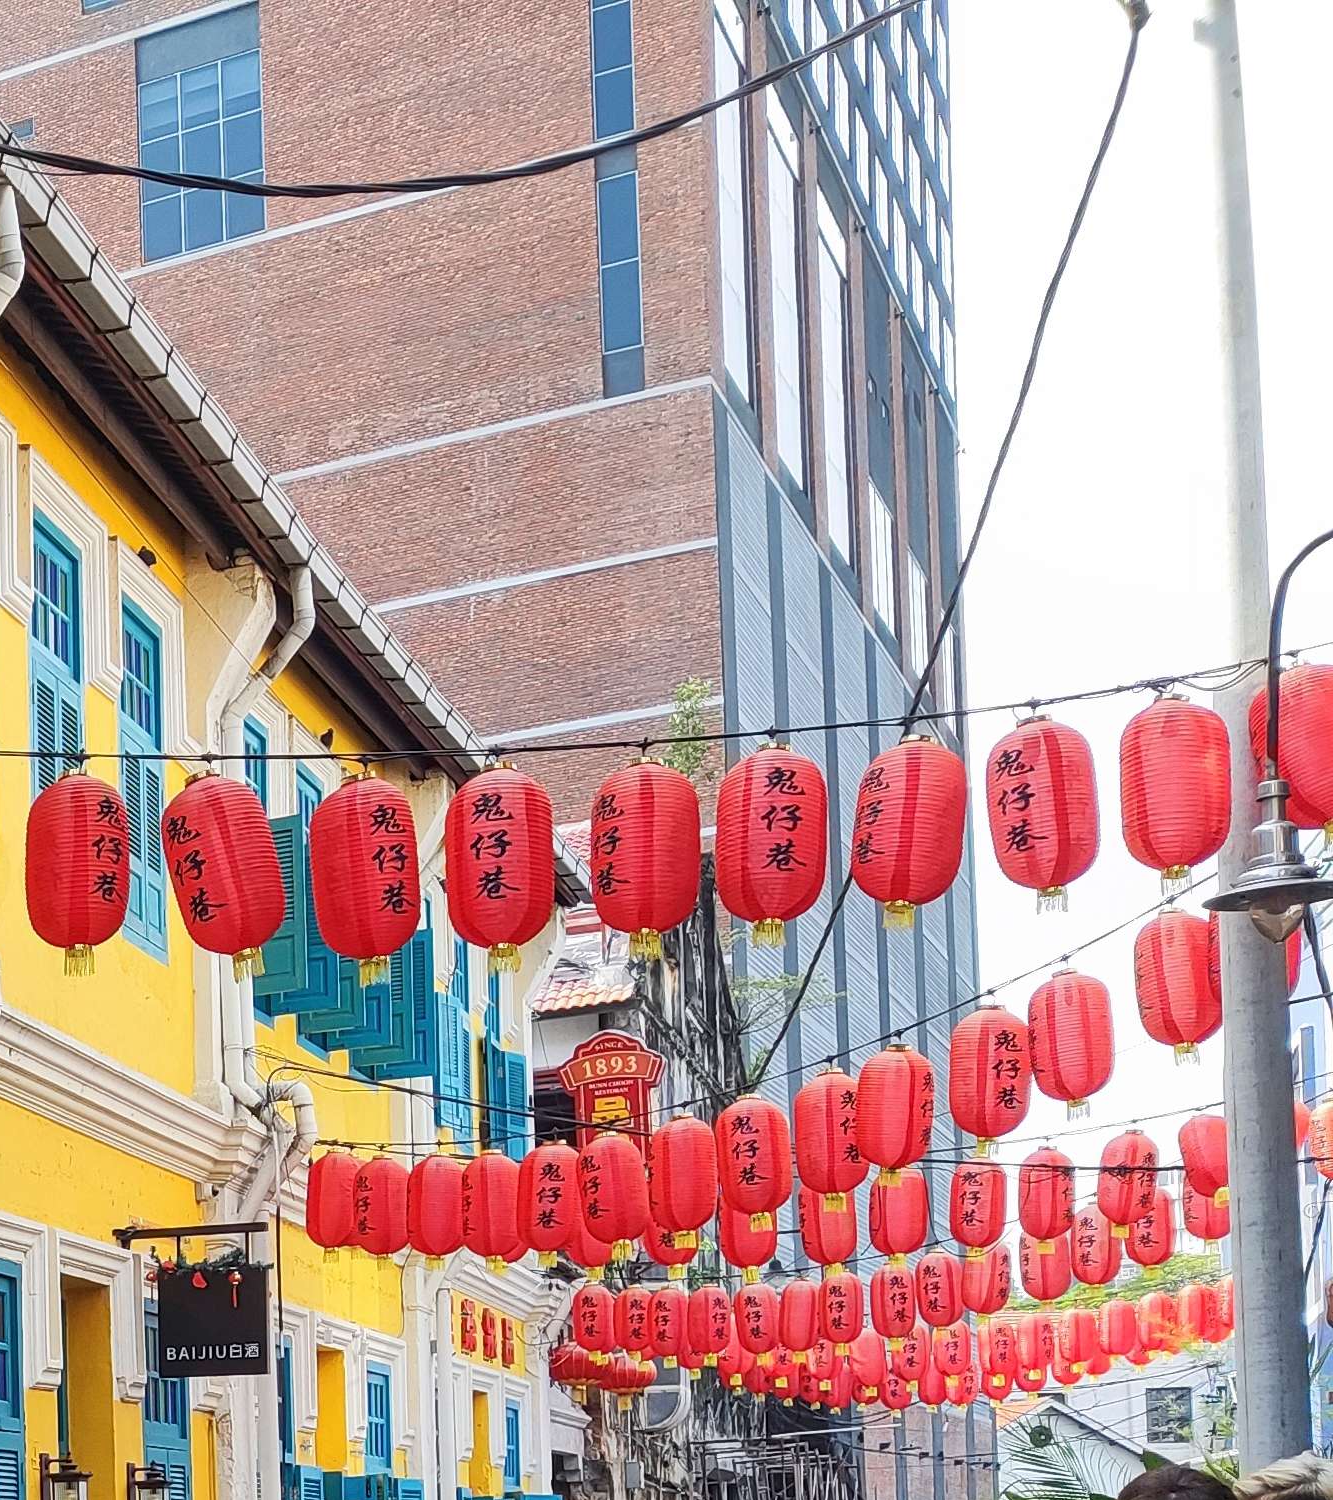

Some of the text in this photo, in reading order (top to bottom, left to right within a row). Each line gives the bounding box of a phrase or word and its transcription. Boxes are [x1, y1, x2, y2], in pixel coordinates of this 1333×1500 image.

[761, 766, 807, 871] 鬼仔巷
[853, 766, 890, 865] 鬼仔巷
[995, 749, 1048, 854] 鬼仔巷
[89, 795, 127, 903] 鬼仔巷
[166, 815, 229, 923] 鬼仔巷
[369, 804, 415, 915] 鬼仔巷
[470, 793, 520, 900] 鬼仔巷
[593, 794, 631, 896] 鬼仔巷
[582, 1055, 638, 1079] 1893
[594, 1041, 624, 1051] SINCE
[992, 1029, 1023, 1110] 鬼仔巷
[731, 1115, 770, 1186] 鬼仔巷
[355, 1175, 377, 1236] 鬼仔巷
[536, 1161, 565, 1229] 鬼仔巷
[580, 1154, 611, 1220] 鬼仔巷
[959, 1170, 984, 1228] 鬼仔巷
[1078, 1216, 1099, 1267] 鬼仔巷
[581, 1296, 601, 1338] 鬼仔巷
[629, 1298, 646, 1340] 鬼仔巷
[712, 1297, 729, 1340] 鬼仔巷
[744, 1296, 768, 1340] 鬼仔巷
[828, 1285, 849, 1330] 鬼仔巷
[889, 1275, 911, 1323] 鬼仔巷
[923, 1264, 946, 1313] 鬼仔巷
[653, 1300, 673, 1342] 鬼仔巷
